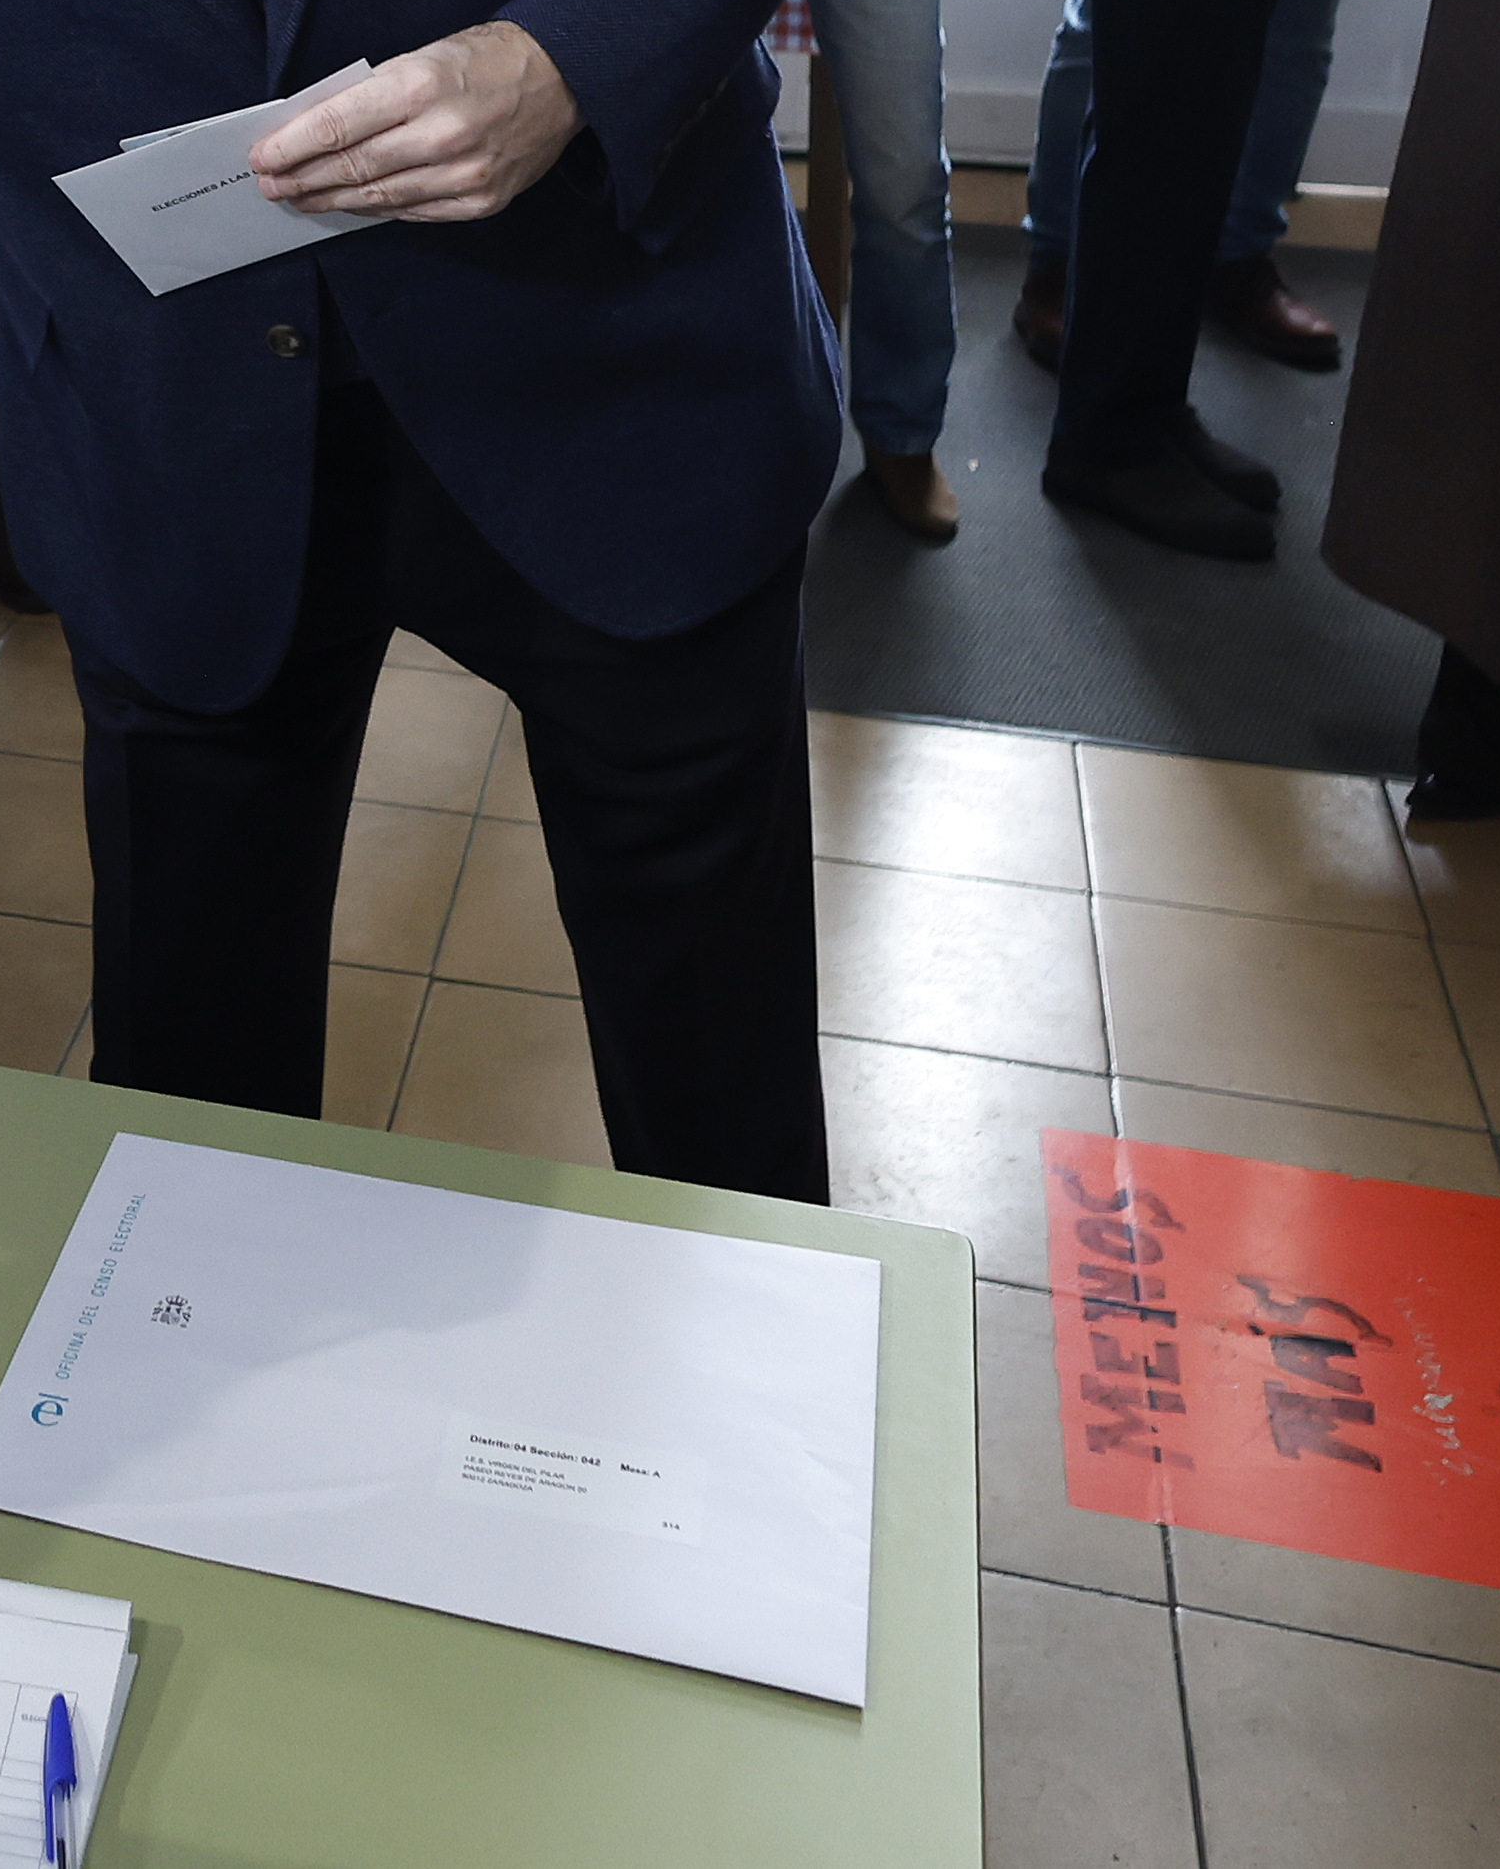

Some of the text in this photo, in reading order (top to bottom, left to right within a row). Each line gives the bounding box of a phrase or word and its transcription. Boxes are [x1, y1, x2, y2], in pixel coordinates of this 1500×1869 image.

[151, 171, 251, 212] ELECCIONES A LAS
[55, 1192, 146, 1380] OFICINA DEL CENSO ELECTORAL
[1051, 1166, 1196, 1471] MENOS
[1235, 1274, 1394, 1473] MÁS
[530, 1446, 579, 1463] Sección:
[581, 1455, 601, 1467] 042
[652, 1470, 661, 1479] A
